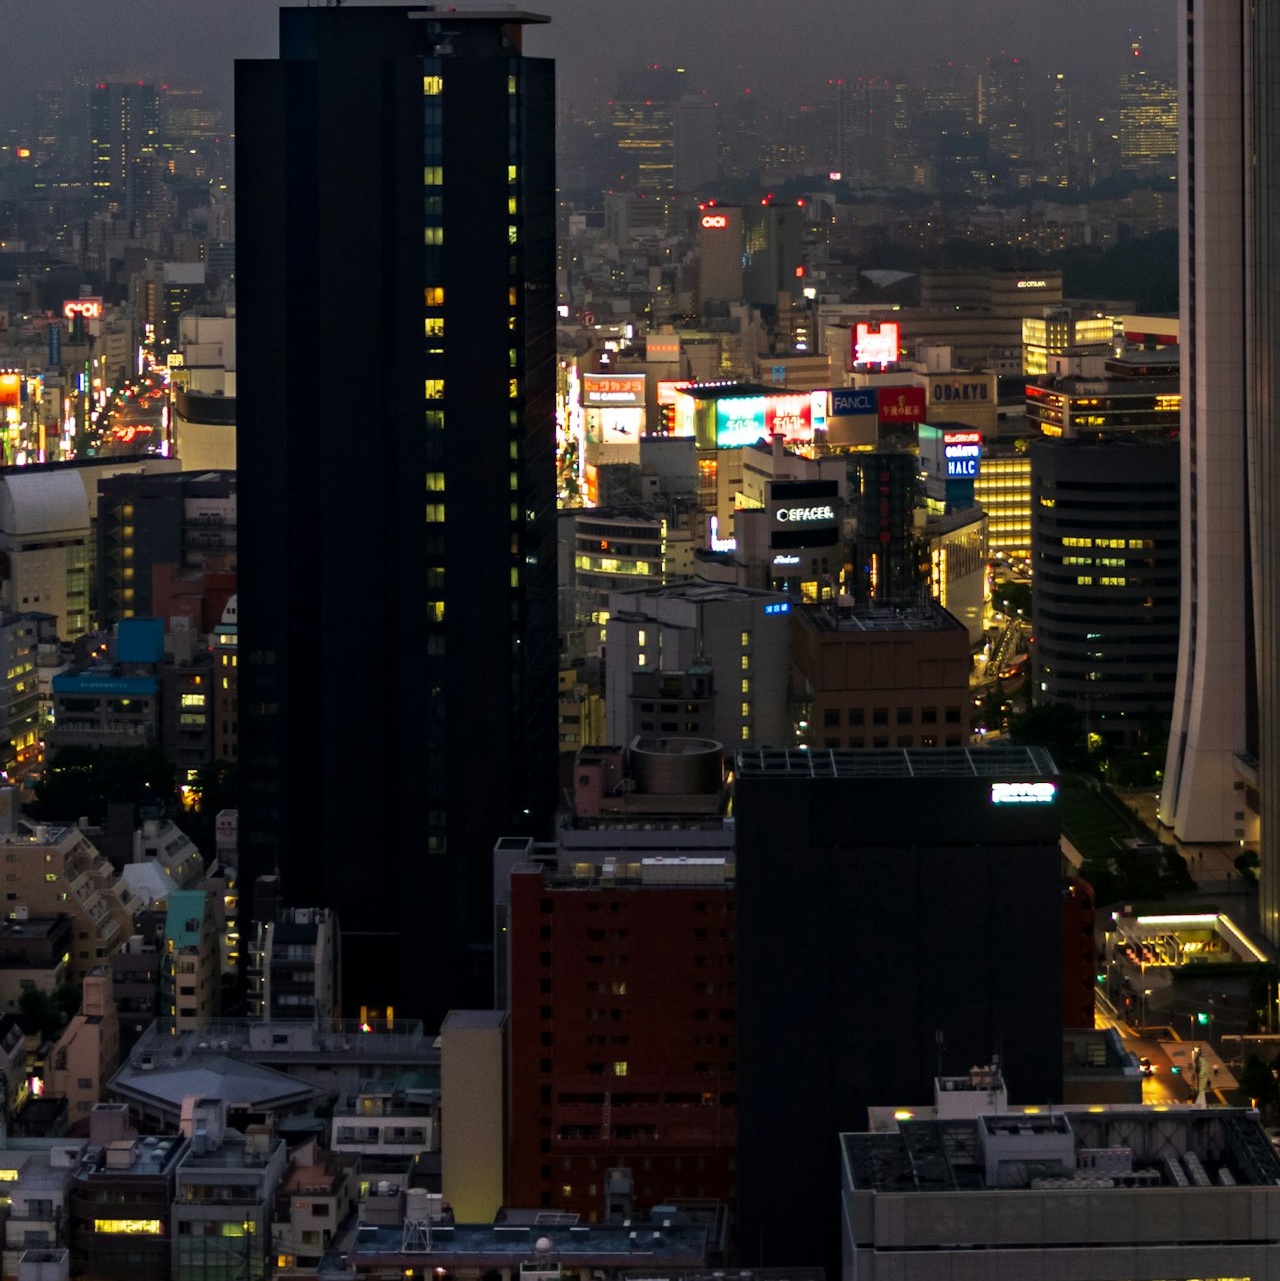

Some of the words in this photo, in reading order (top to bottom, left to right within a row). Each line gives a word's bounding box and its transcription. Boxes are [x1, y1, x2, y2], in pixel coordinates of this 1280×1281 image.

[584, 379, 643, 392] ビックカメラ
[933, 383, 988, 401] ODAKYU
[834, 396, 872, 410] FANCL
[882, 405, 920, 416] 午後の紅茶
[948, 460, 975, 475] HALC
